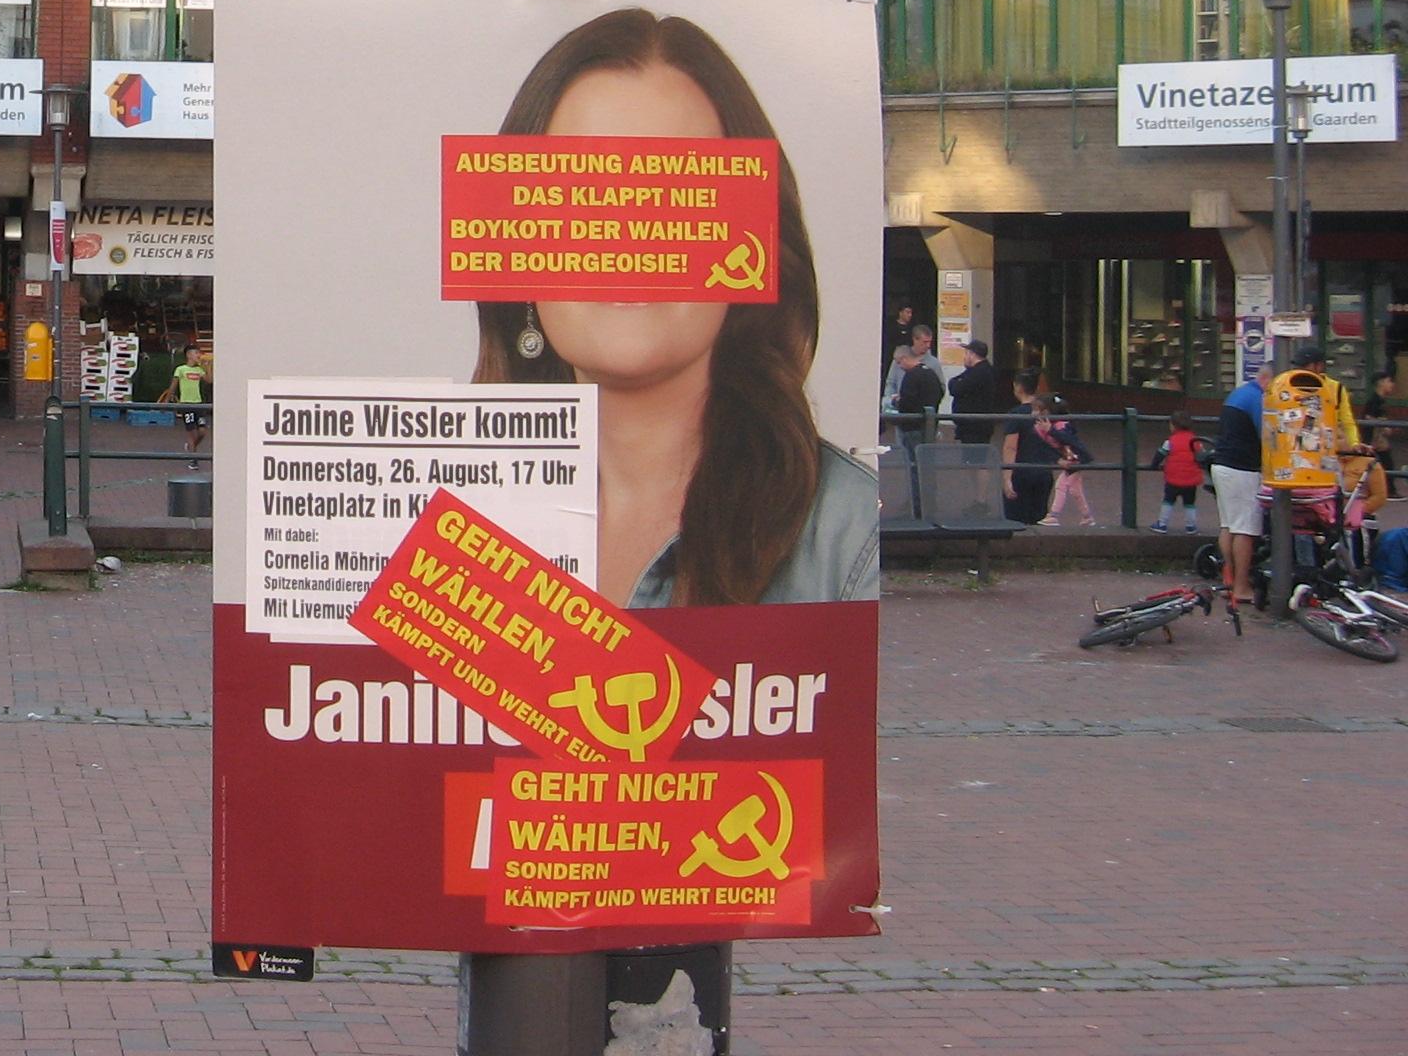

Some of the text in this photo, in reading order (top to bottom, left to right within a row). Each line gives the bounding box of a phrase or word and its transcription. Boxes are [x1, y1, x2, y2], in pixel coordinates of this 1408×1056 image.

[183, 82, 211, 93] Mehr
[182, 110, 209, 120] Haus
[1312, 112, 1377, 127] Gaarden
[455, 151, 769, 181] AUSBEUTUNG ABWÄHLEN,
[513, 186, 717, 208] DAS KLAPPT NIE!
[127, 231, 178, 245] TÄGLICH
[450, 219, 729, 241] BOYKOTT DER WAHLEN
[133, 247, 182, 259] FLEISCH
[185, 248, 194, 259] &
[450, 251, 688, 273] DER BOURGEOISIE!
[264, 403, 577, 439] Janine Wissler kommt!
[263, 456, 577, 488] Donnerstag, 26. August, 17 Uhr
[263, 491, 375, 520] Vinetaplatz
[383, 493, 401, 518] in
[264, 528, 319, 543] Mit dabei:
[264, 550, 330, 570] Cornelia
[435, 510, 631, 653] GEHT NICHT
[264, 598, 287, 619] Mit
[388, 581, 487, 657] SONDERN
[409, 546, 559, 676] WÄHLEN,
[372, 604, 455, 669] KÄMPFT
[453, 658, 497, 698] UND
[498, 687, 570, 745] WEHRT
[510, 770, 719, 802] GEHT NICHT
[507, 814, 670, 857] WÄHLEN,
[504, 861, 610, 881] SONDERN
[504, 886, 776, 909] KÄMPFT UND WEHRT EUCH!
